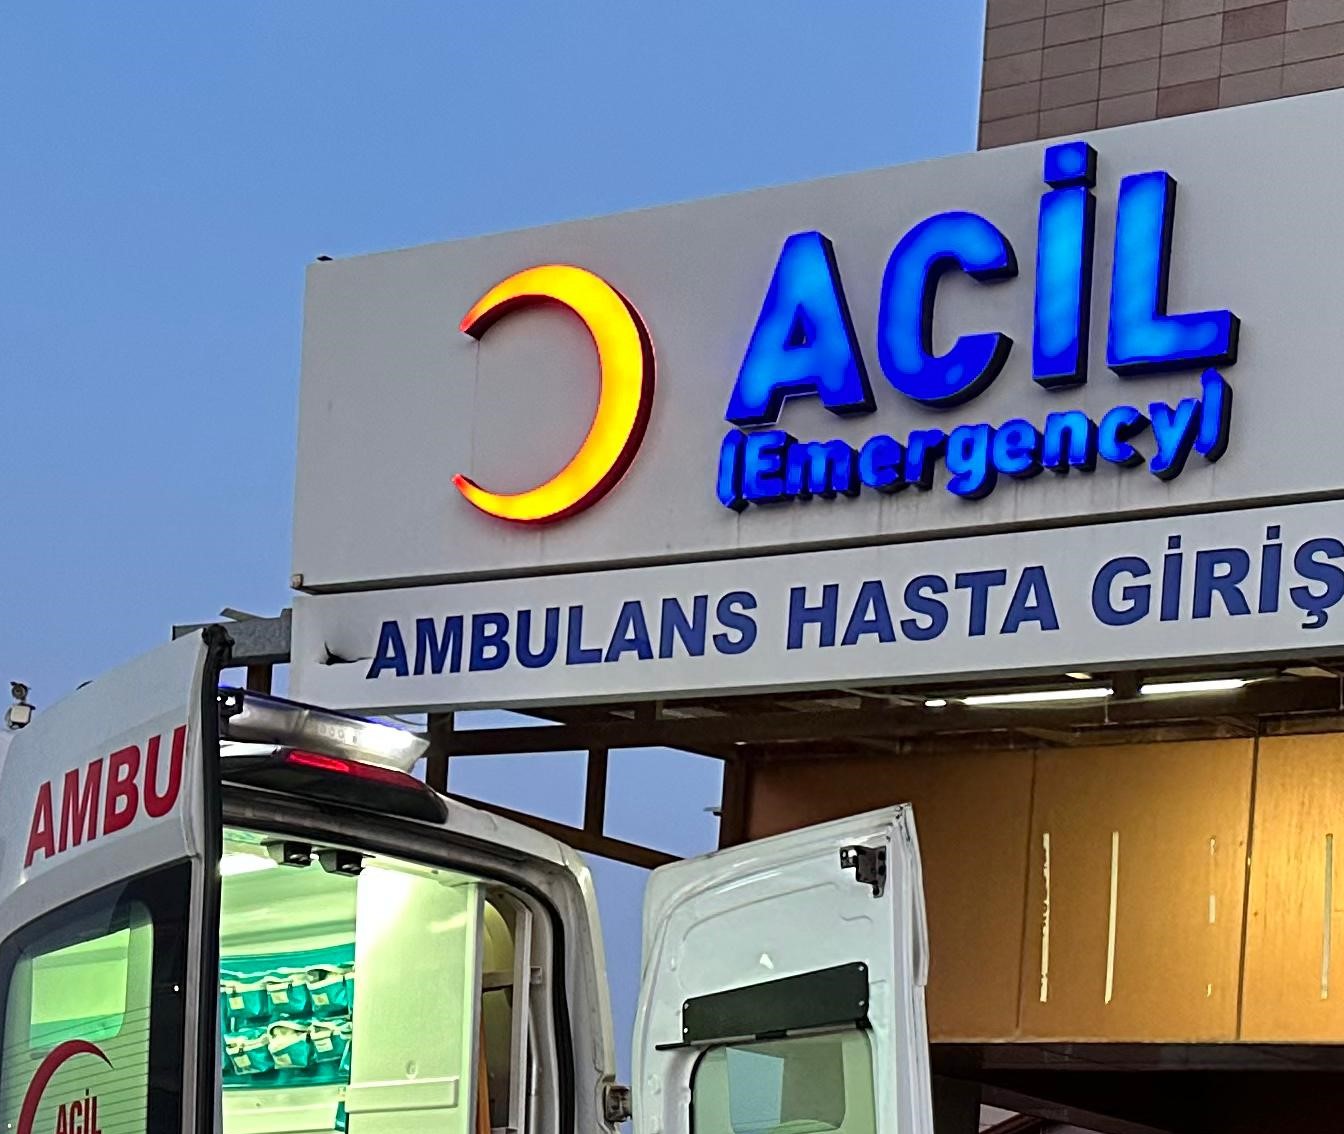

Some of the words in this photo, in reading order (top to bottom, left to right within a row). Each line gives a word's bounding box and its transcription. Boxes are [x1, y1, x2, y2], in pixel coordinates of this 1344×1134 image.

[725, 141, 1239, 428] ACİL
[716, 367, 1233, 511] (Emergency)
[366, 593, 759, 680] AMBULANS
[786, 564, 1060, 651] HASTA
[24, 724, 187, 869] AMBU
